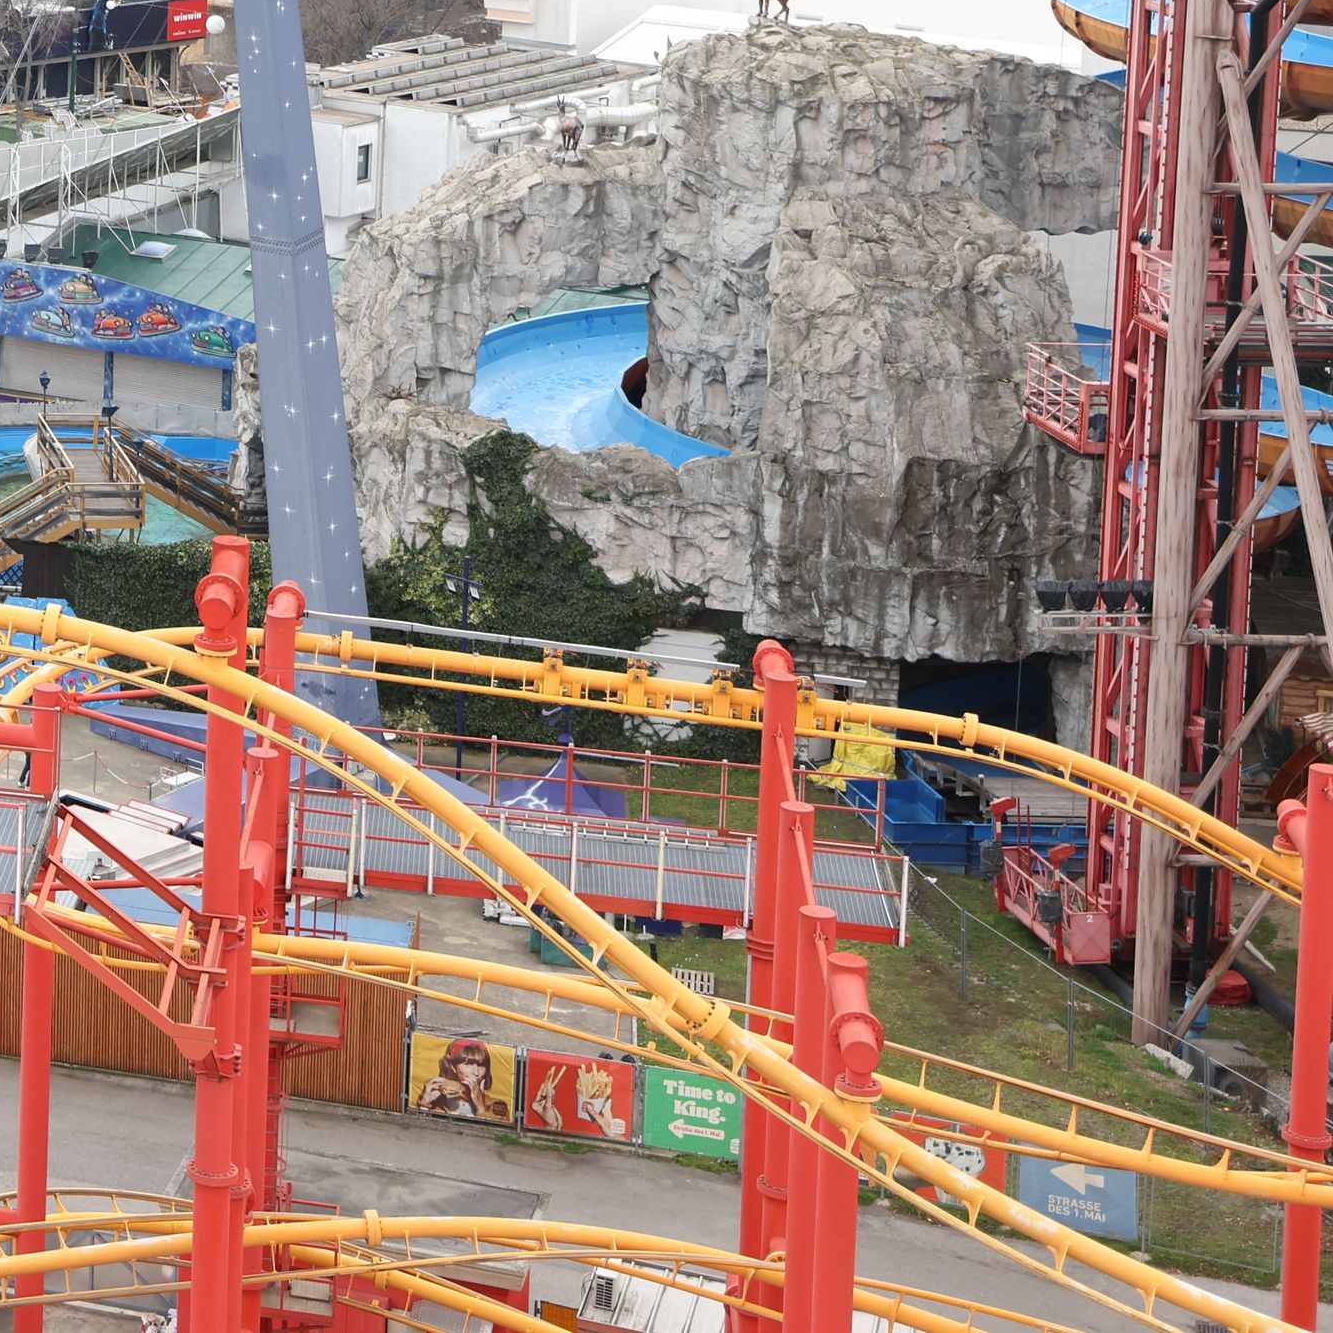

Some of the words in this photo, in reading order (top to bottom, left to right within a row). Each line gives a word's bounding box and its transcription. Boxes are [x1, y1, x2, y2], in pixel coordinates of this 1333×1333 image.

[1086, 914, 1094, 923] 2
[663, 1079, 713, 1101] Time
[716, 1089, 736, 1104] to
[674, 1099, 726, 1124] King.
[694, 1127, 705, 1135] des
[1048, 1194, 1101, 1212] STRASSE
[1048, 1203, 1070, 1216] DES
